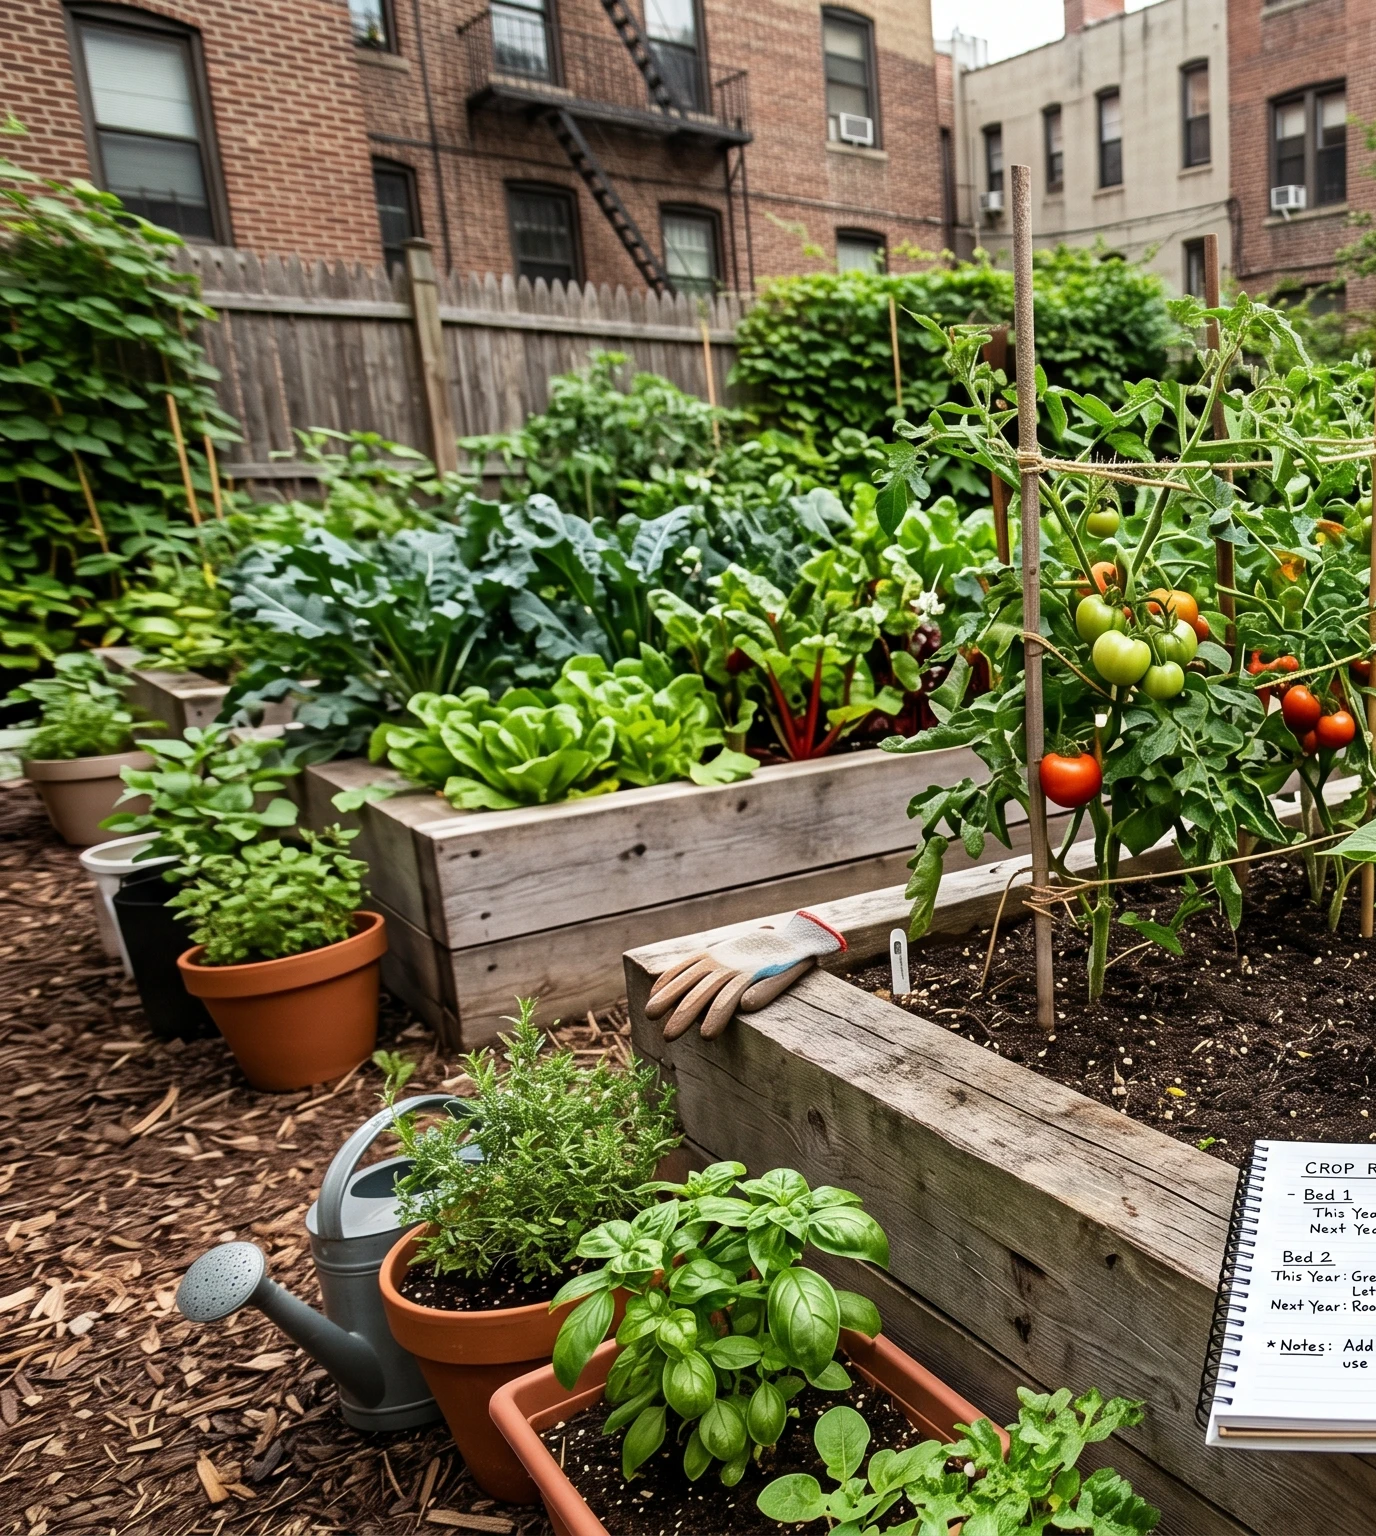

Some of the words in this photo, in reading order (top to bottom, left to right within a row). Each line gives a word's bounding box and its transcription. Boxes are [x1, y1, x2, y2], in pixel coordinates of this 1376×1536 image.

[1306, 1162, 1354, 1174] CROP
[1305, 1189, 1334, 1200] Bed
[1344, 1190, 1352, 1200] 1
[1313, 1208, 1344, 1218] This
[1310, 1223, 1346, 1233] Next
[1284, 1251, 1312, 1263] Bed
[1321, 1252, 1332, 1262] 2
[1271, 1271, 1301, 1281] This
[1271, 1299, 1304, 1310] Next
[1343, 1339, 1373, 1351] Add
